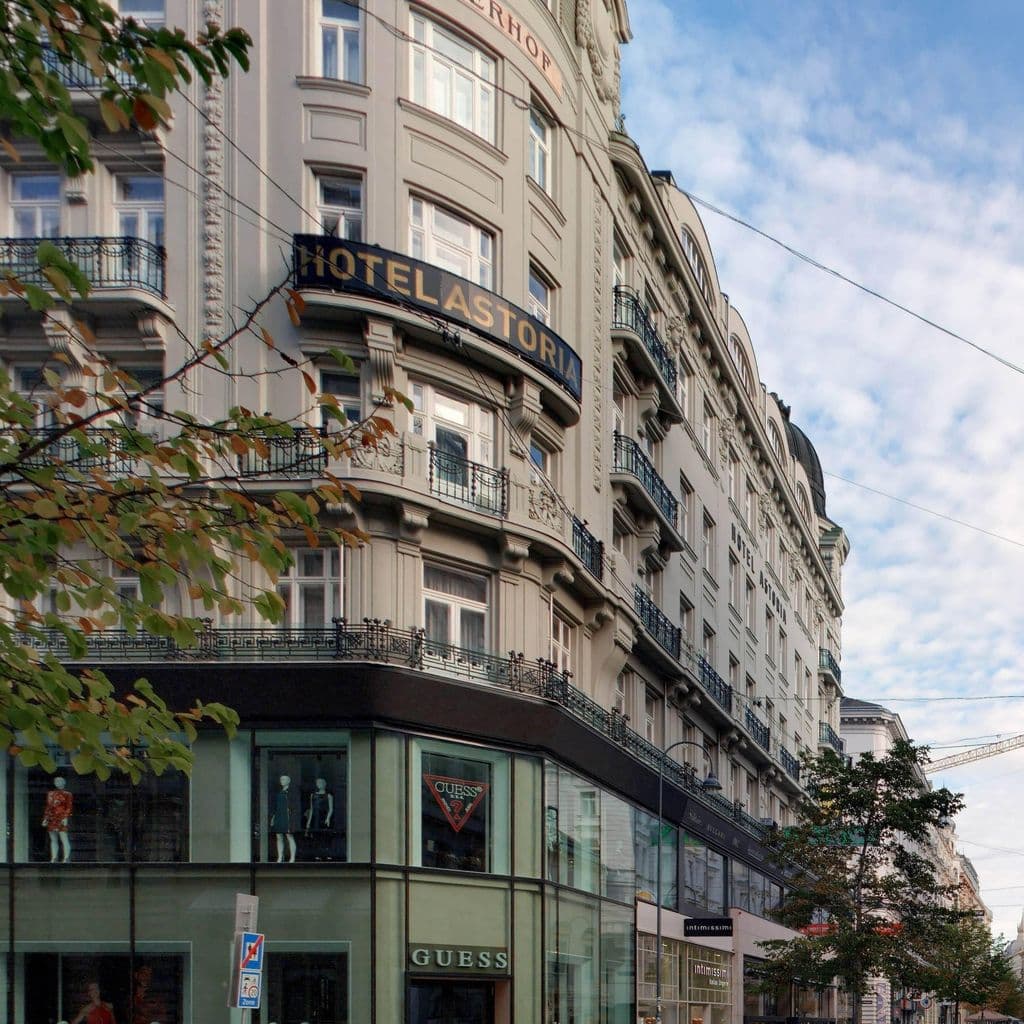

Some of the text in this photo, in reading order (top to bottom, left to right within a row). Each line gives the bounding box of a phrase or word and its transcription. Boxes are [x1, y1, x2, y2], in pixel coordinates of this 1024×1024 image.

[301, 246, 578, 388] HOTEL ASTORIA
[731, 522, 787, 625] HOTEL ASTORIA
[411, 949, 508, 969] GUESS
